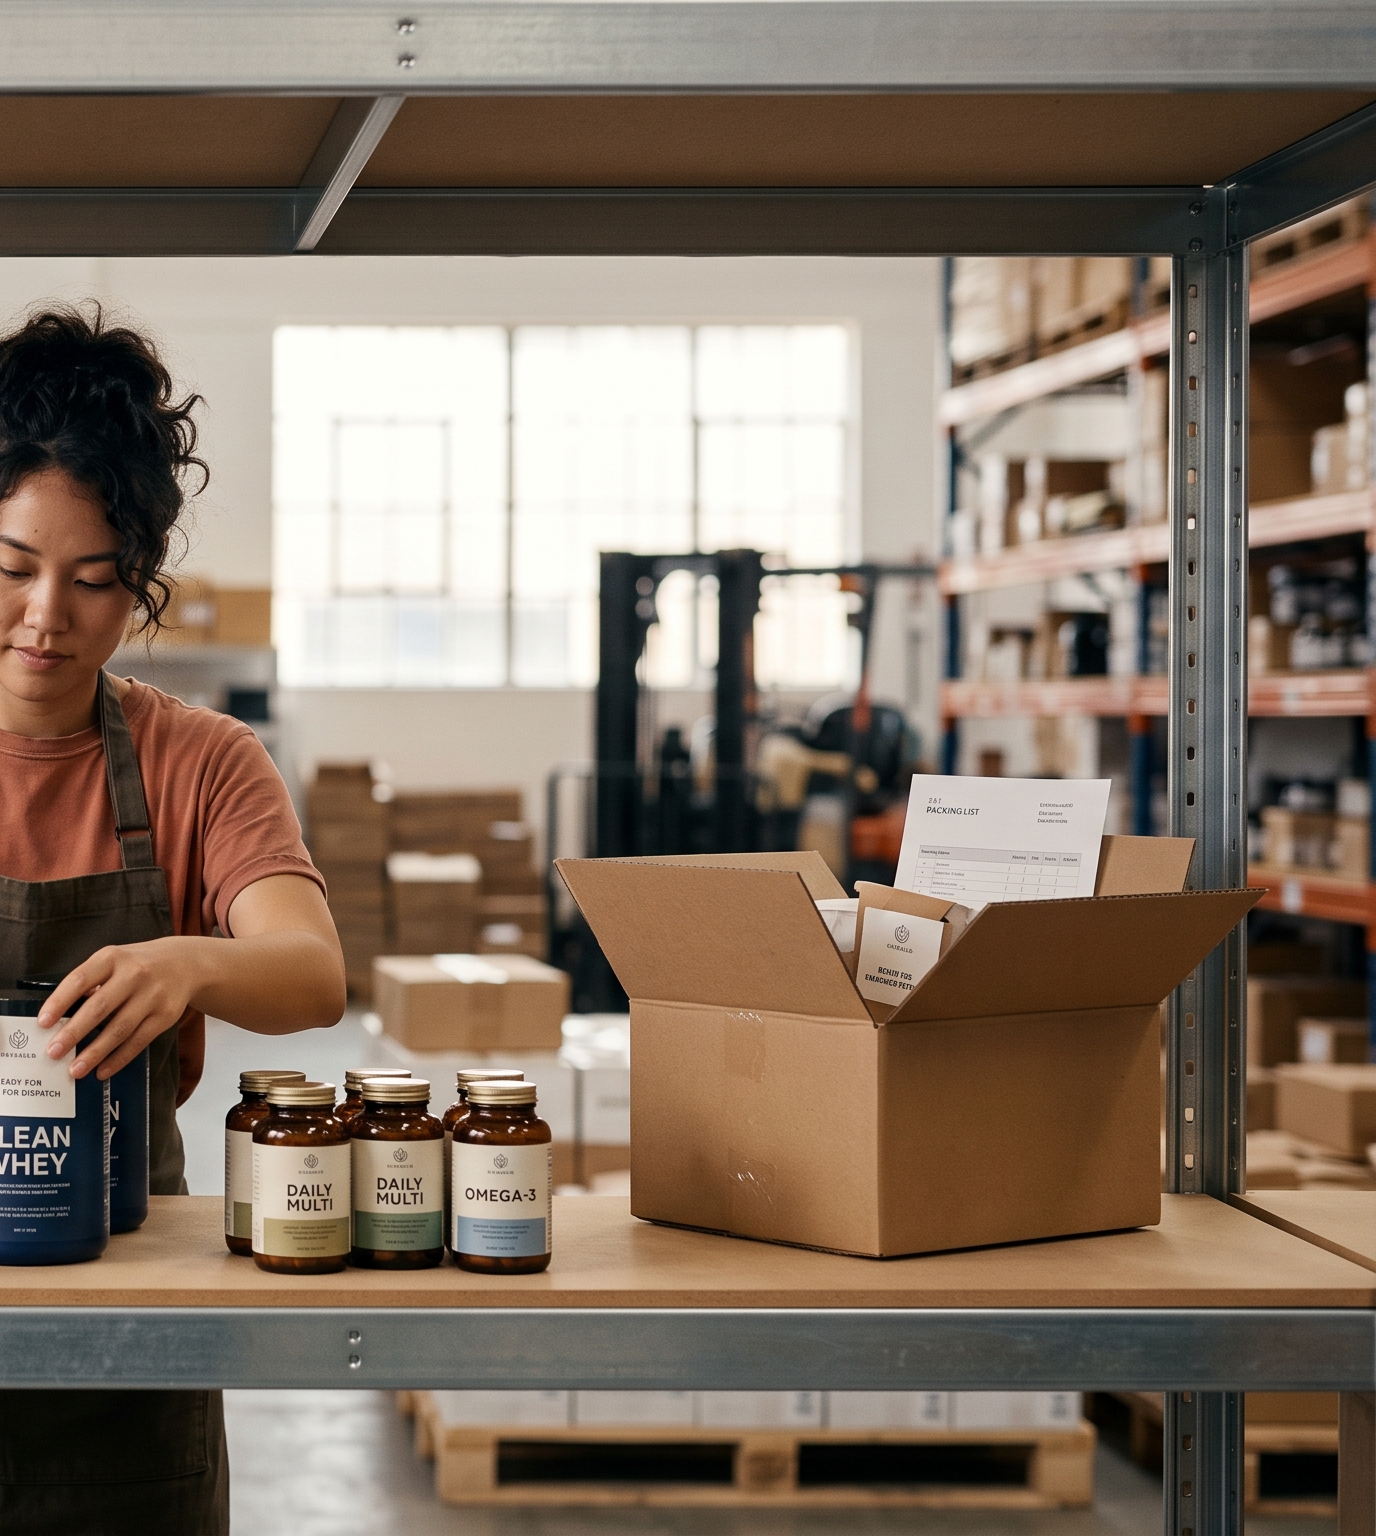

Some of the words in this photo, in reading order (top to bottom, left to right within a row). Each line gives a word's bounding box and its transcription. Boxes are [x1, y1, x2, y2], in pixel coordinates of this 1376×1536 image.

[926, 806, 963, 815] PACKING
[963, 808, 980, 816] LIST
[21, 1089, 61, 1098] DISPATCH
[287, 1183, 333, 1197] DAILY
[376, 1177, 423, 1191] DAILY
[376, 1192, 424, 1205] MULTI
[465, 1187, 537, 1202] OMEGA-3
[287, 1198, 333, 1211] MULTI
